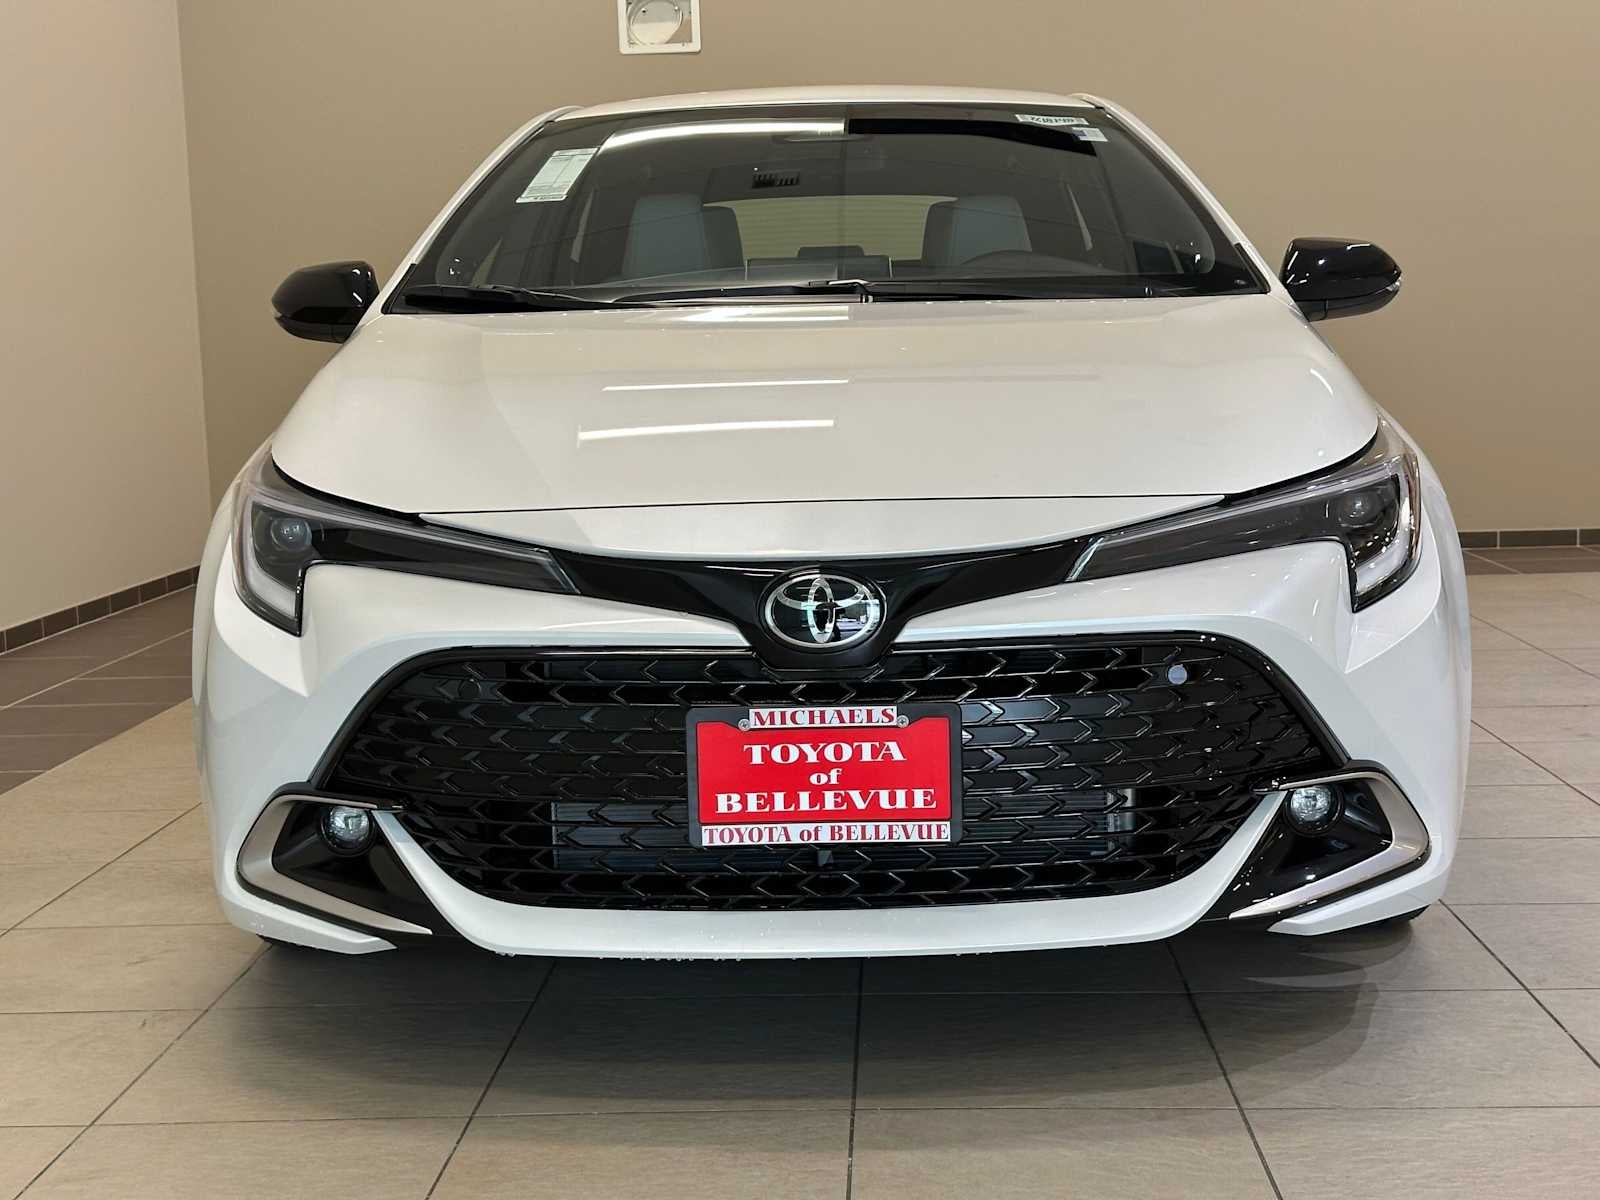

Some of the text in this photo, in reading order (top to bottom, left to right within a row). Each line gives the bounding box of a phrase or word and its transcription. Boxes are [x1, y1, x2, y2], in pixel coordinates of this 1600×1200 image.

[754, 708, 895, 726] MICHAELS
[743, 741, 907, 764] TOYOTA
[809, 768, 843, 785] of
[715, 788, 937, 814] BELLEVUE
[704, 823, 949, 844] TOYOTA of BELLEVUE
